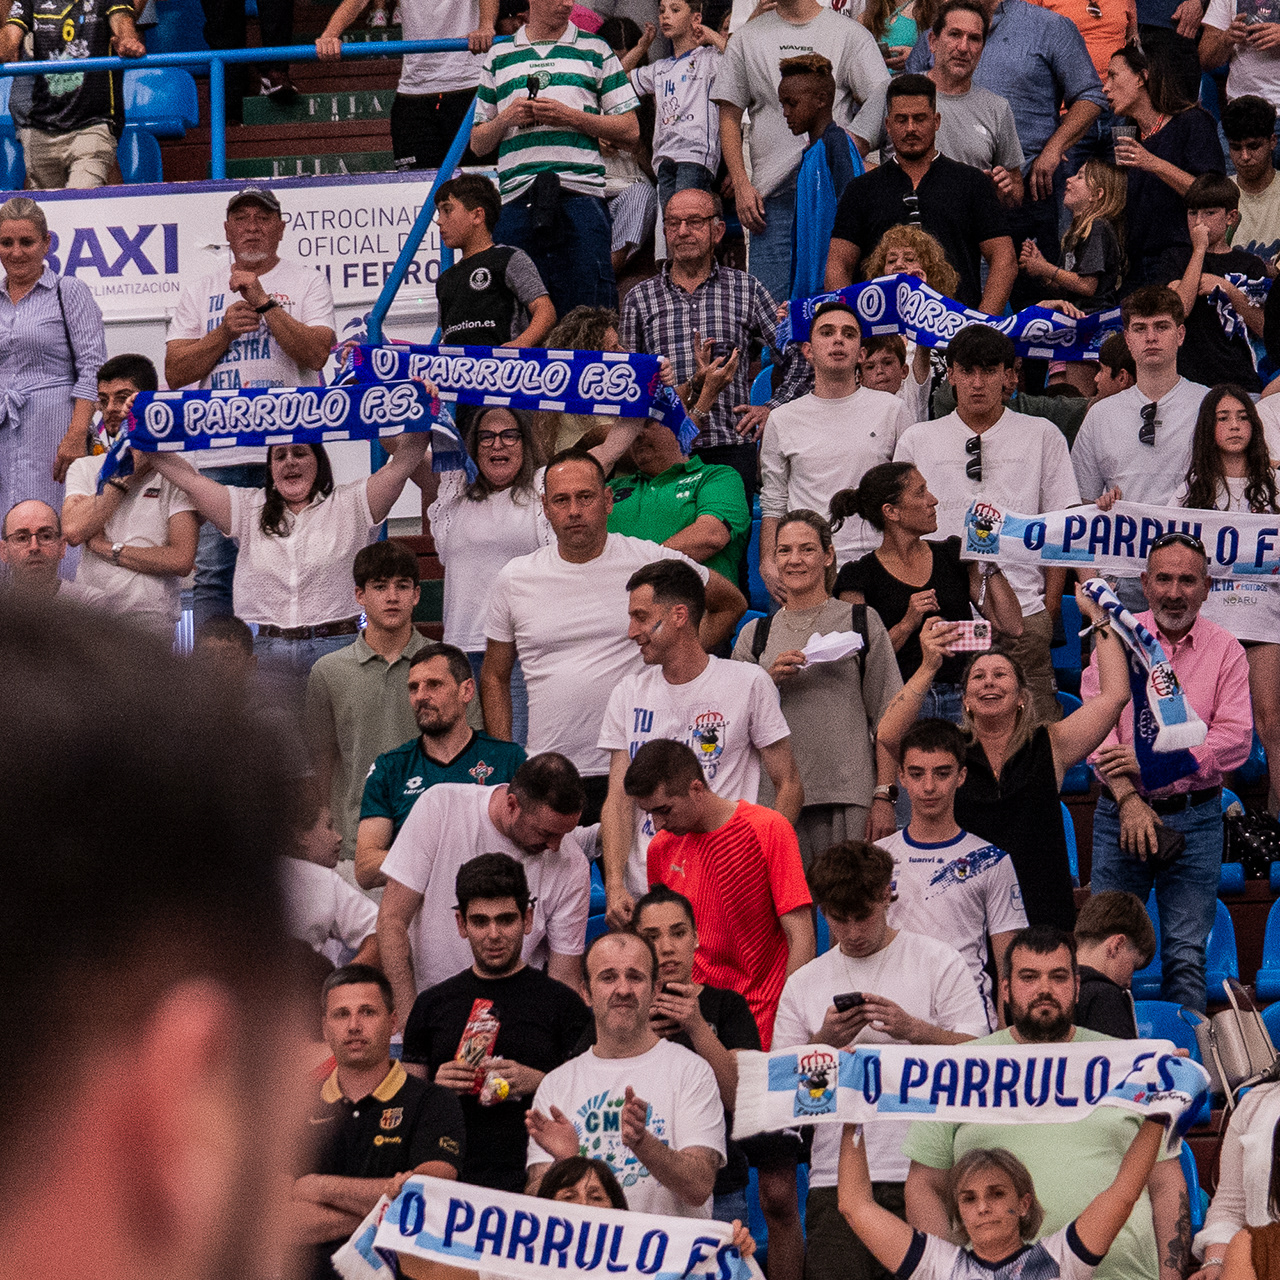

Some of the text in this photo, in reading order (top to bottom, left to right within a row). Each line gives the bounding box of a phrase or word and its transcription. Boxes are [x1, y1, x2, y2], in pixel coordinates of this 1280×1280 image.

[62, 18, 75, 42] 6
[778, 45, 814, 53] WAVES
[298, 233, 389, 258] OFICIAL
[857, 284, 886, 322] O
[371, 347, 400, 382] O
[407, 353, 572, 398] PARRULO
[145, 400, 173, 439] O
[183, 394, 350, 438] PARRULO
[1022, 519, 1047, 551] O
[633, 706, 655, 733] TU
[861, 1054, 882, 1104] O
[899, 1055, 1111, 1107] PARRULO
[399, 1189, 425, 1237] O
[443, 1199, 669, 1274] PARRULO
